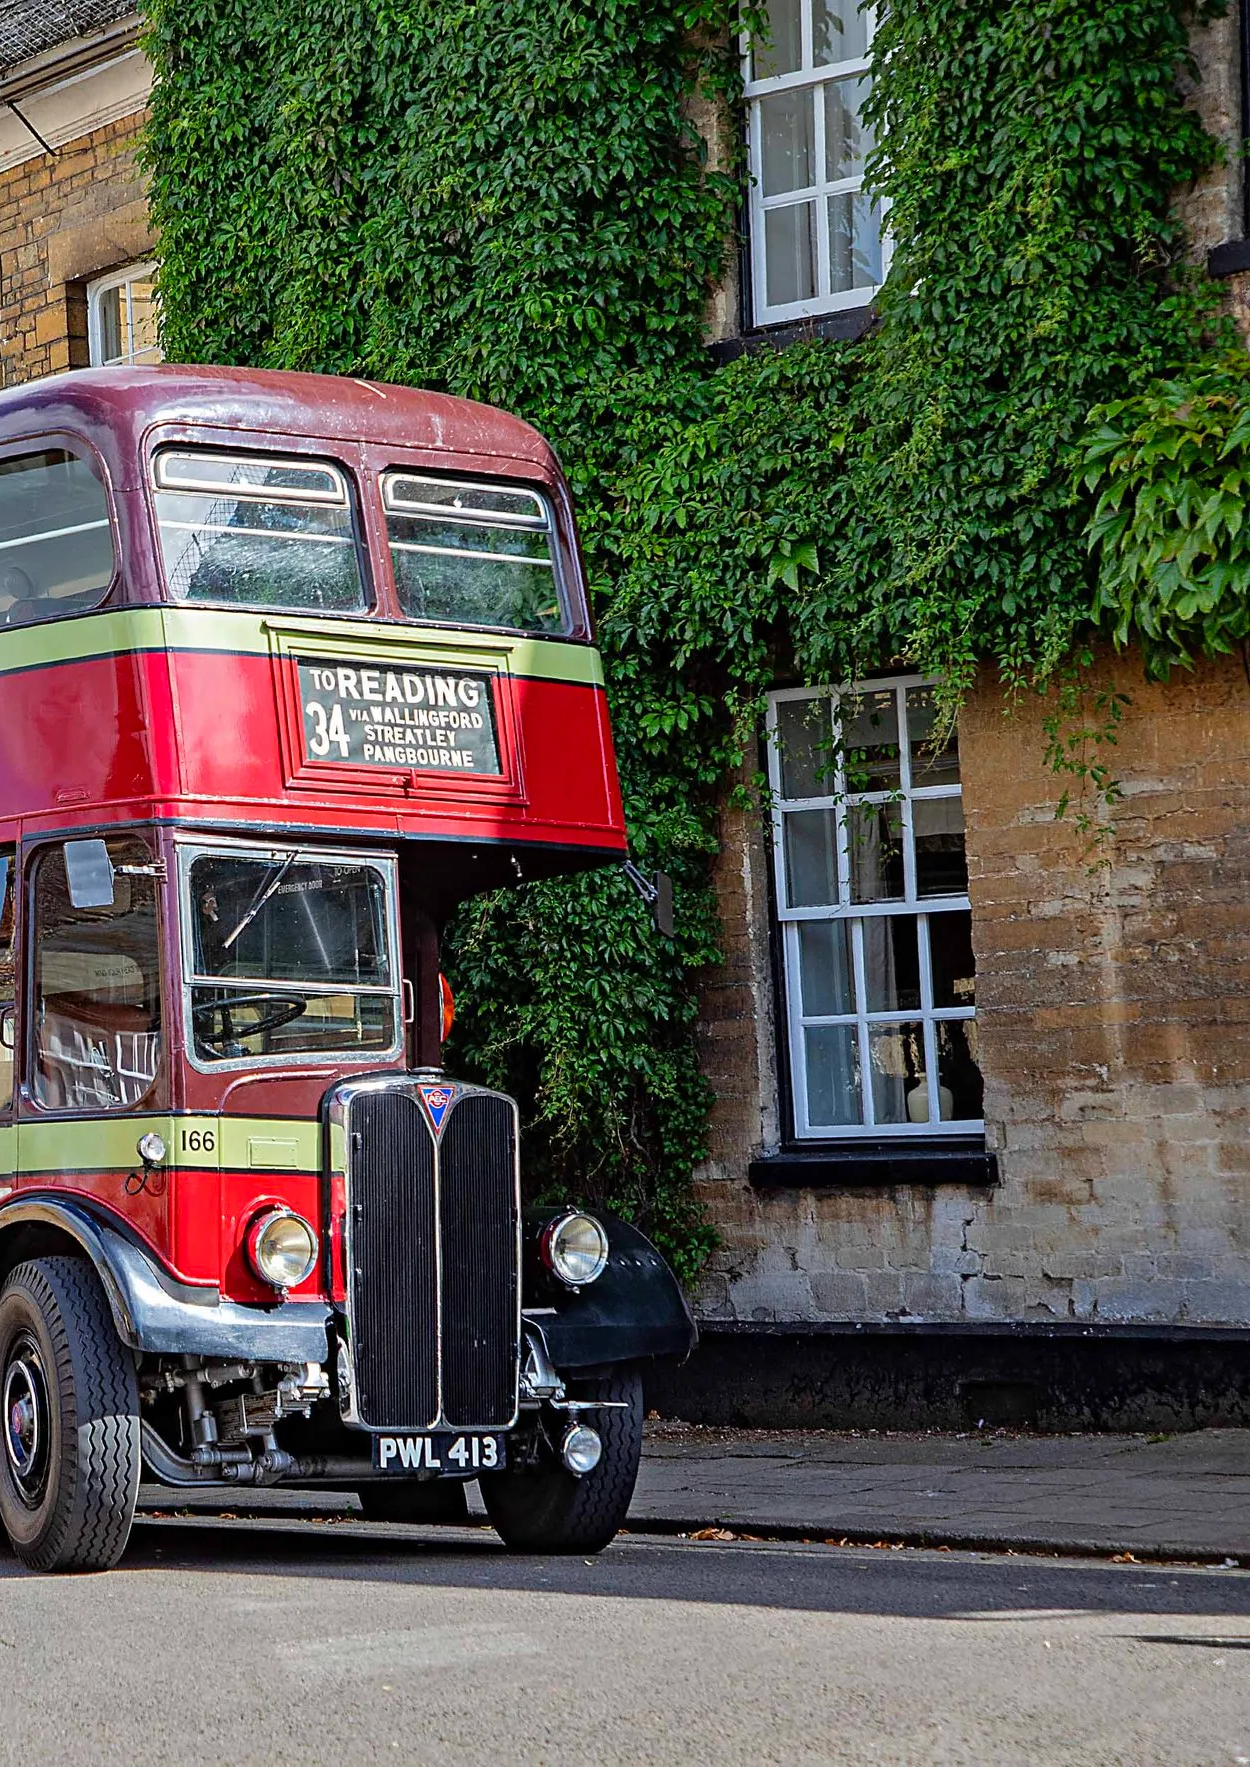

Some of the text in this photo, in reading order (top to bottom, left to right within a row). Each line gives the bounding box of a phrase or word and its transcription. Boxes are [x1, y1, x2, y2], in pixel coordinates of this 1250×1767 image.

[310, 667, 480, 708] TO READING
[349, 706, 483, 729] VIA WALLINGFORD
[305, 701, 351, 758] 34
[364, 725, 456, 747] STREATLEY
[363, 746, 474, 768] PANGBOURNE
[427, 1095, 448, 1103] AEC
[181, 1130, 215, 1152] 166
[379, 1436, 498, 1469] PWL 413
